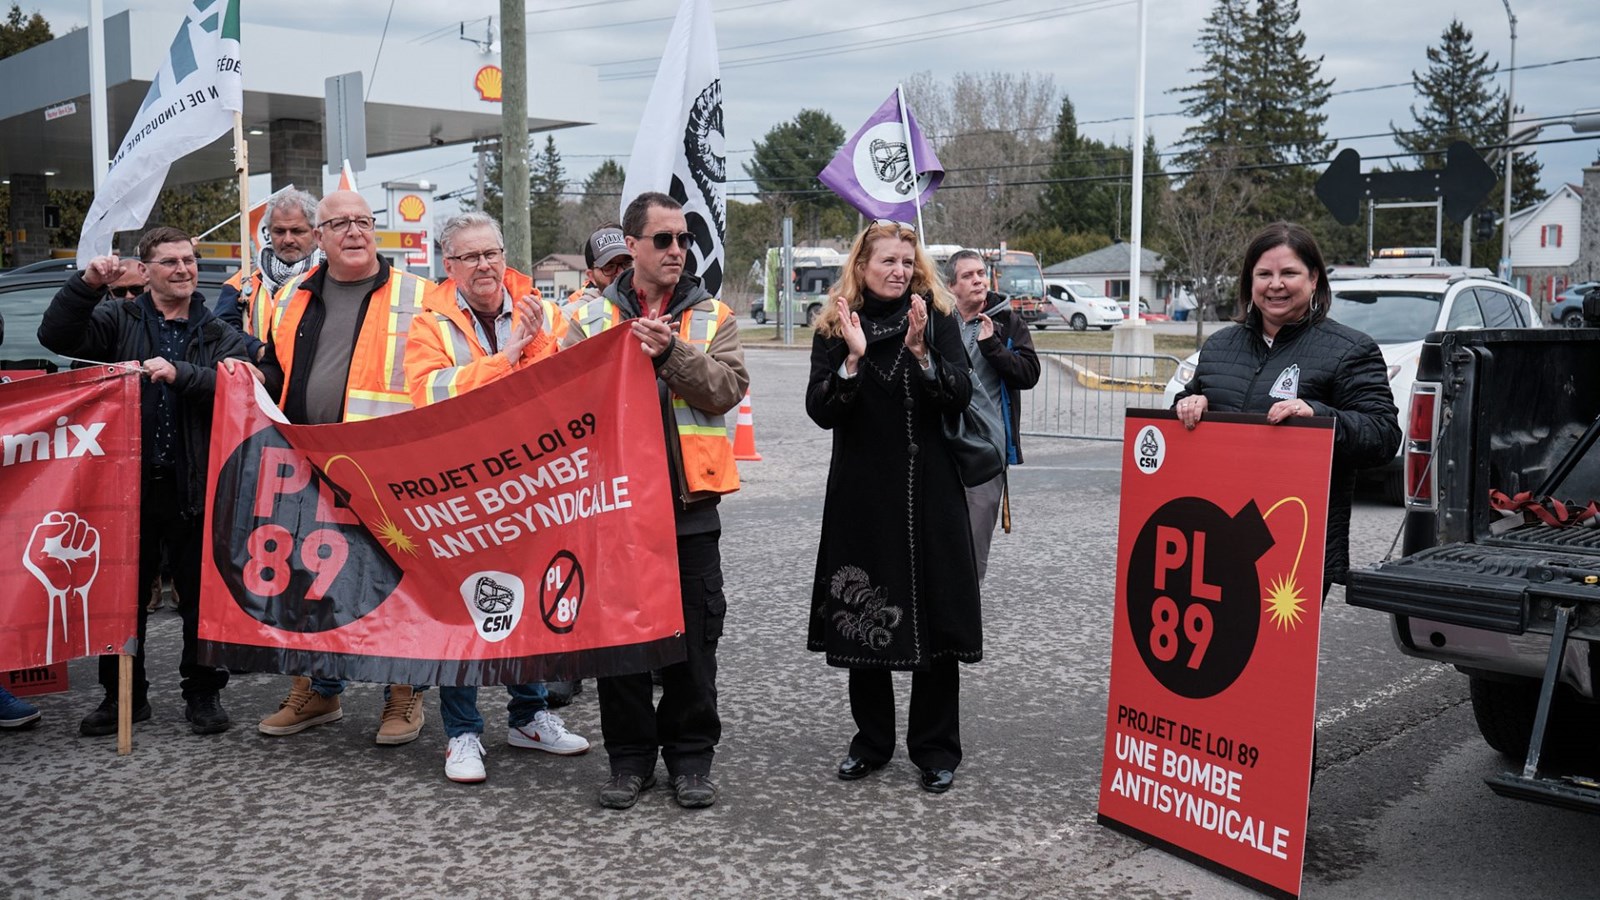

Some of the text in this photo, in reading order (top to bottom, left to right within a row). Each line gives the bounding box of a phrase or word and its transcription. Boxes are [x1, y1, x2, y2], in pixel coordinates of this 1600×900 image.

[404, 234, 413, 247] 6
[253, 446, 360, 525] PL
[388, 412, 596, 500] PROJET DE LOI 89
[404, 447, 589, 532] UNE BOMBE
[1139, 457, 1158, 469] CSN
[427, 475, 632, 559] ANTISYNDICALE
[242, 523, 349, 600] 89
[546, 565, 563, 591] PL
[1153, 525, 1222, 602] PL
[482, 614, 513, 633] CSN
[557, 596, 578, 623] 89
[1149, 595, 1214, 670] 89
[1115, 732, 1243, 803] UNE BOMBE
[1117, 704, 1259, 768] PROJET DE LOI 89
[1110, 767, 1290, 861] ANTISYNDICALE
